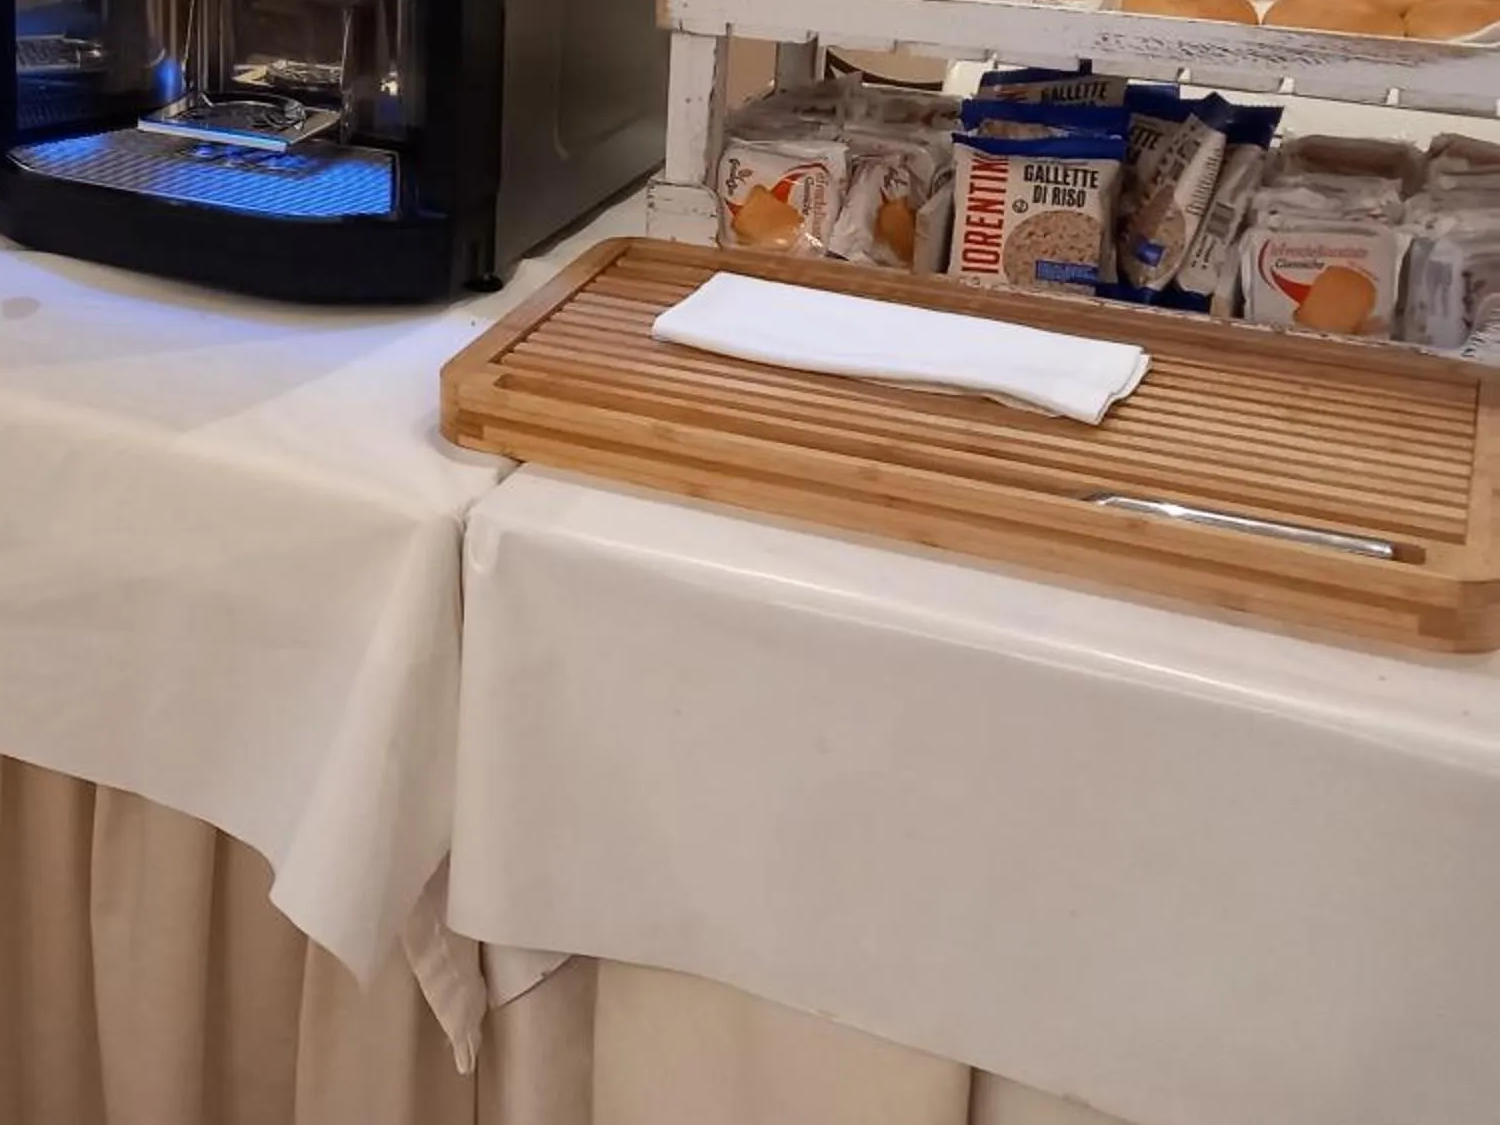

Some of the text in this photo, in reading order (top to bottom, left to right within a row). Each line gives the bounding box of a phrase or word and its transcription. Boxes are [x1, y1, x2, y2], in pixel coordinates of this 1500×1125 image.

[1023, 164, 1100, 189] GALLETTE
[1032, 185, 1087, 208] DI RISO
